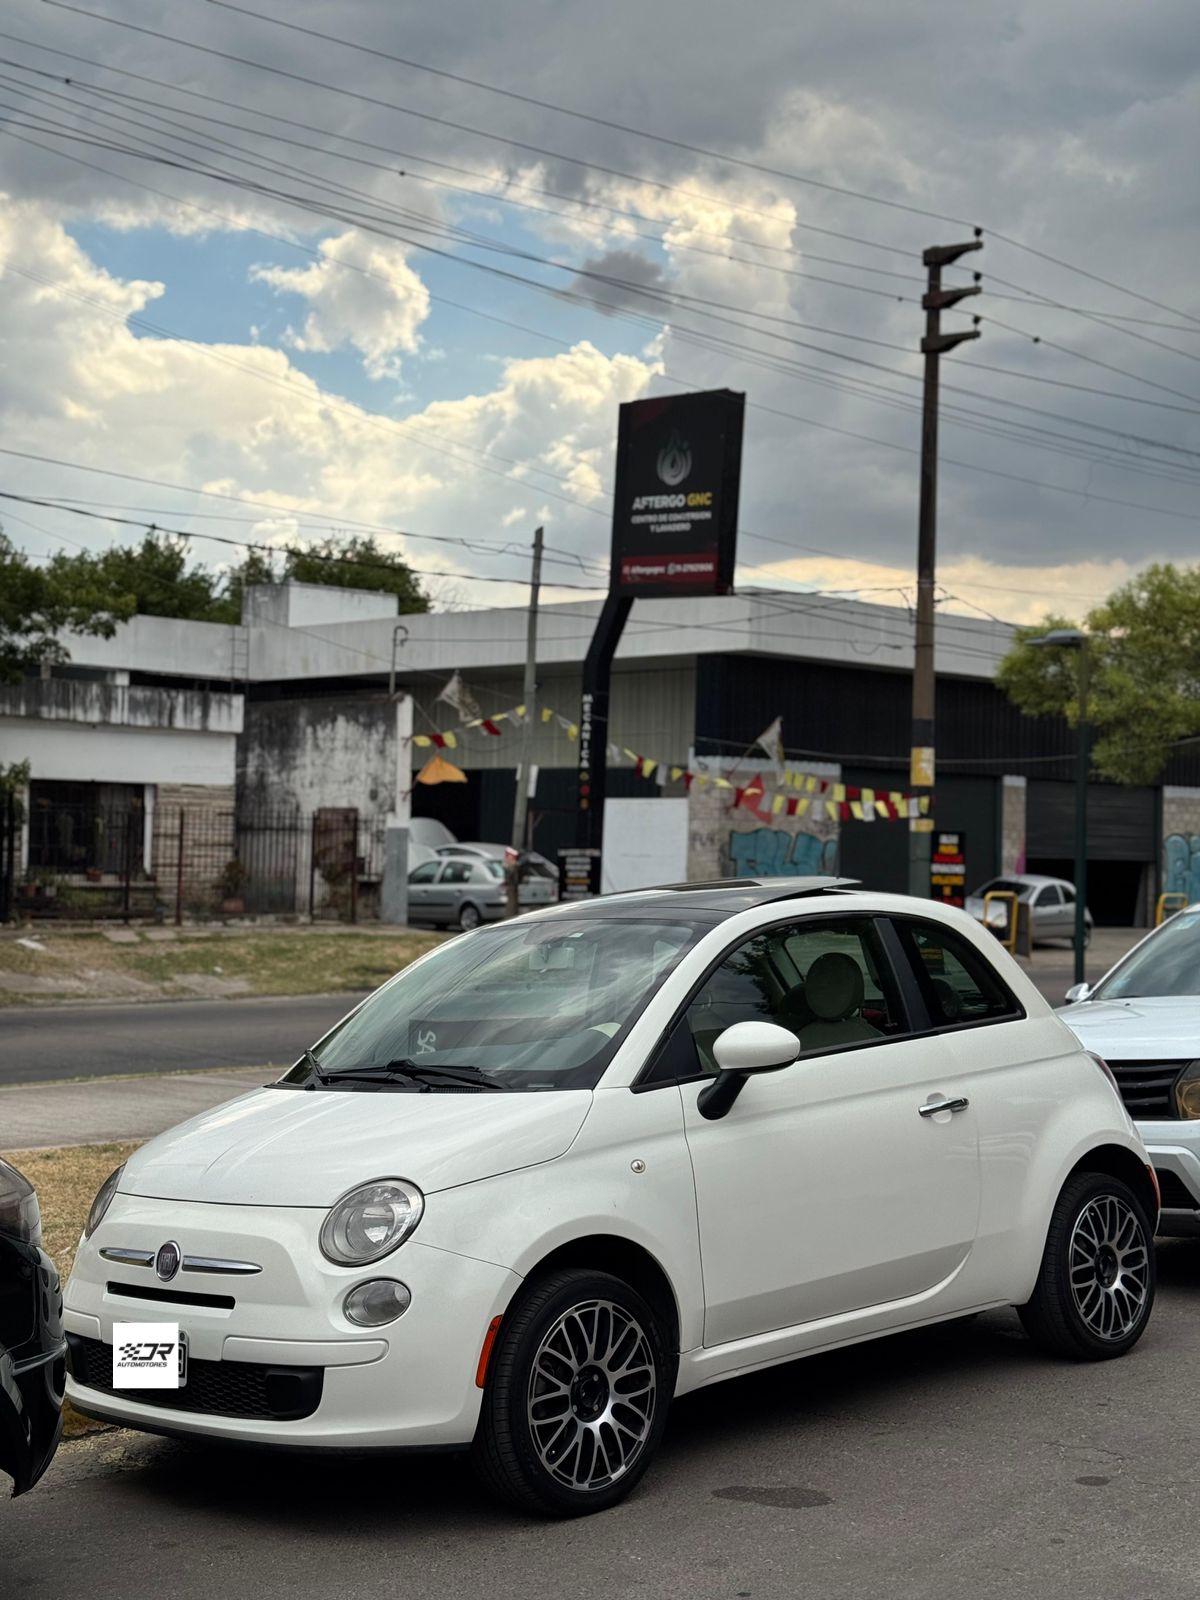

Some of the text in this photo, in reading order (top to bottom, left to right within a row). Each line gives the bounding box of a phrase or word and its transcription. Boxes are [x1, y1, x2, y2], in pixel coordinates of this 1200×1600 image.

[632, 492, 712, 510] AFTERGO GNC
[581, 694, 593, 769] MECANICA
[160, 1253, 175, 1270] FIAT
